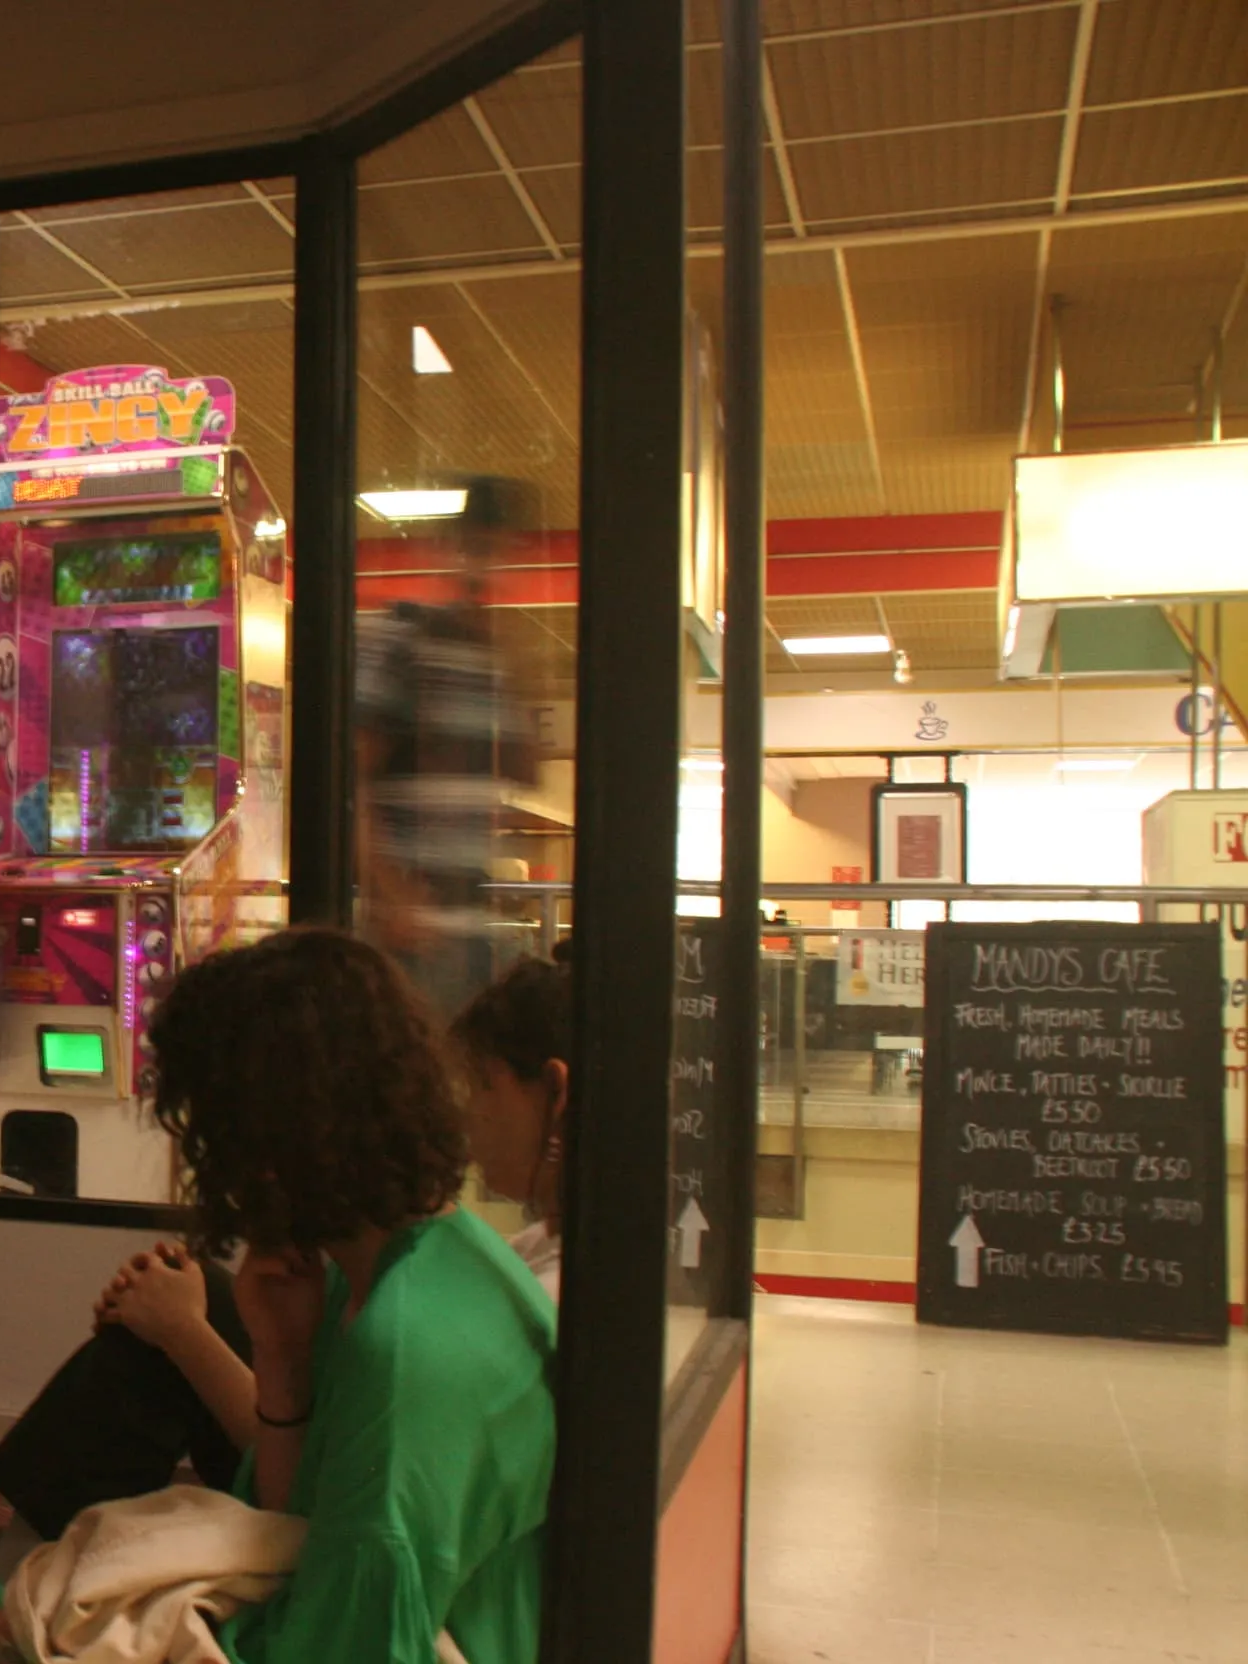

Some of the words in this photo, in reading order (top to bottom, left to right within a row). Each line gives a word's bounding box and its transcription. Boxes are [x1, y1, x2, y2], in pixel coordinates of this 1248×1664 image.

[8, 389, 209, 451] ZINGY
[973, 943, 1083, 986] MANDYS
[1098, 948, 1169, 992] CAFE
[1018, 1003, 1106, 1033] HOMEMADE
[1121, 1006, 1185, 1035] MEALS
[1015, 1033, 1069, 1060] MADE
